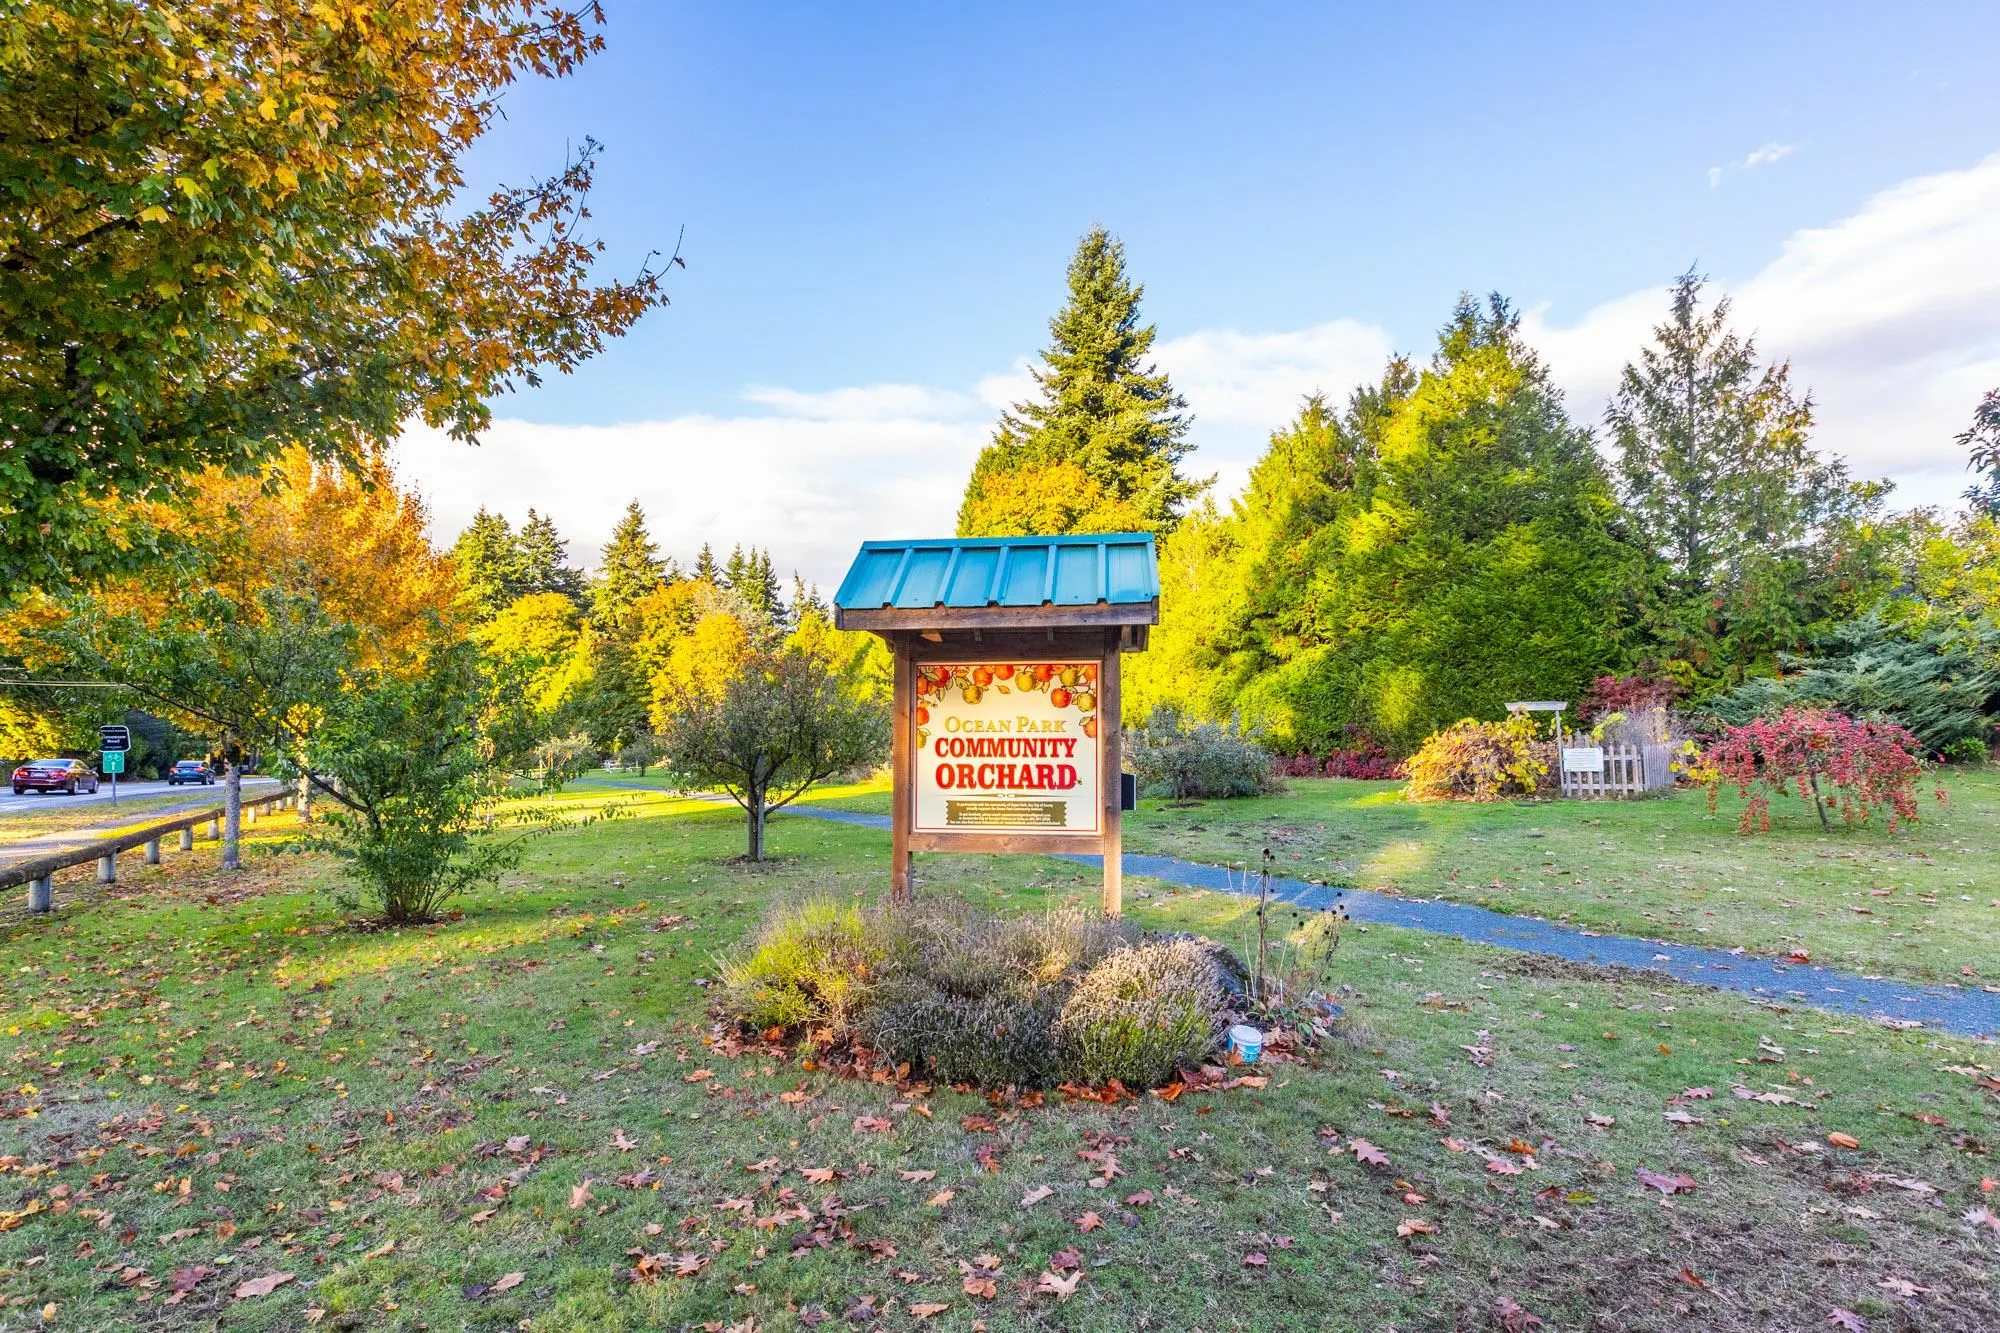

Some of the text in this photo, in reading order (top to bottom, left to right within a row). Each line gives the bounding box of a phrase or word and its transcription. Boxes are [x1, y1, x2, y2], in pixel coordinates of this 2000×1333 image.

[944, 716, 1067, 732] OCEAN PARK
[935, 737, 1077, 758] COMMUNITY
[935, 763, 1077, 790] ORCHARD
